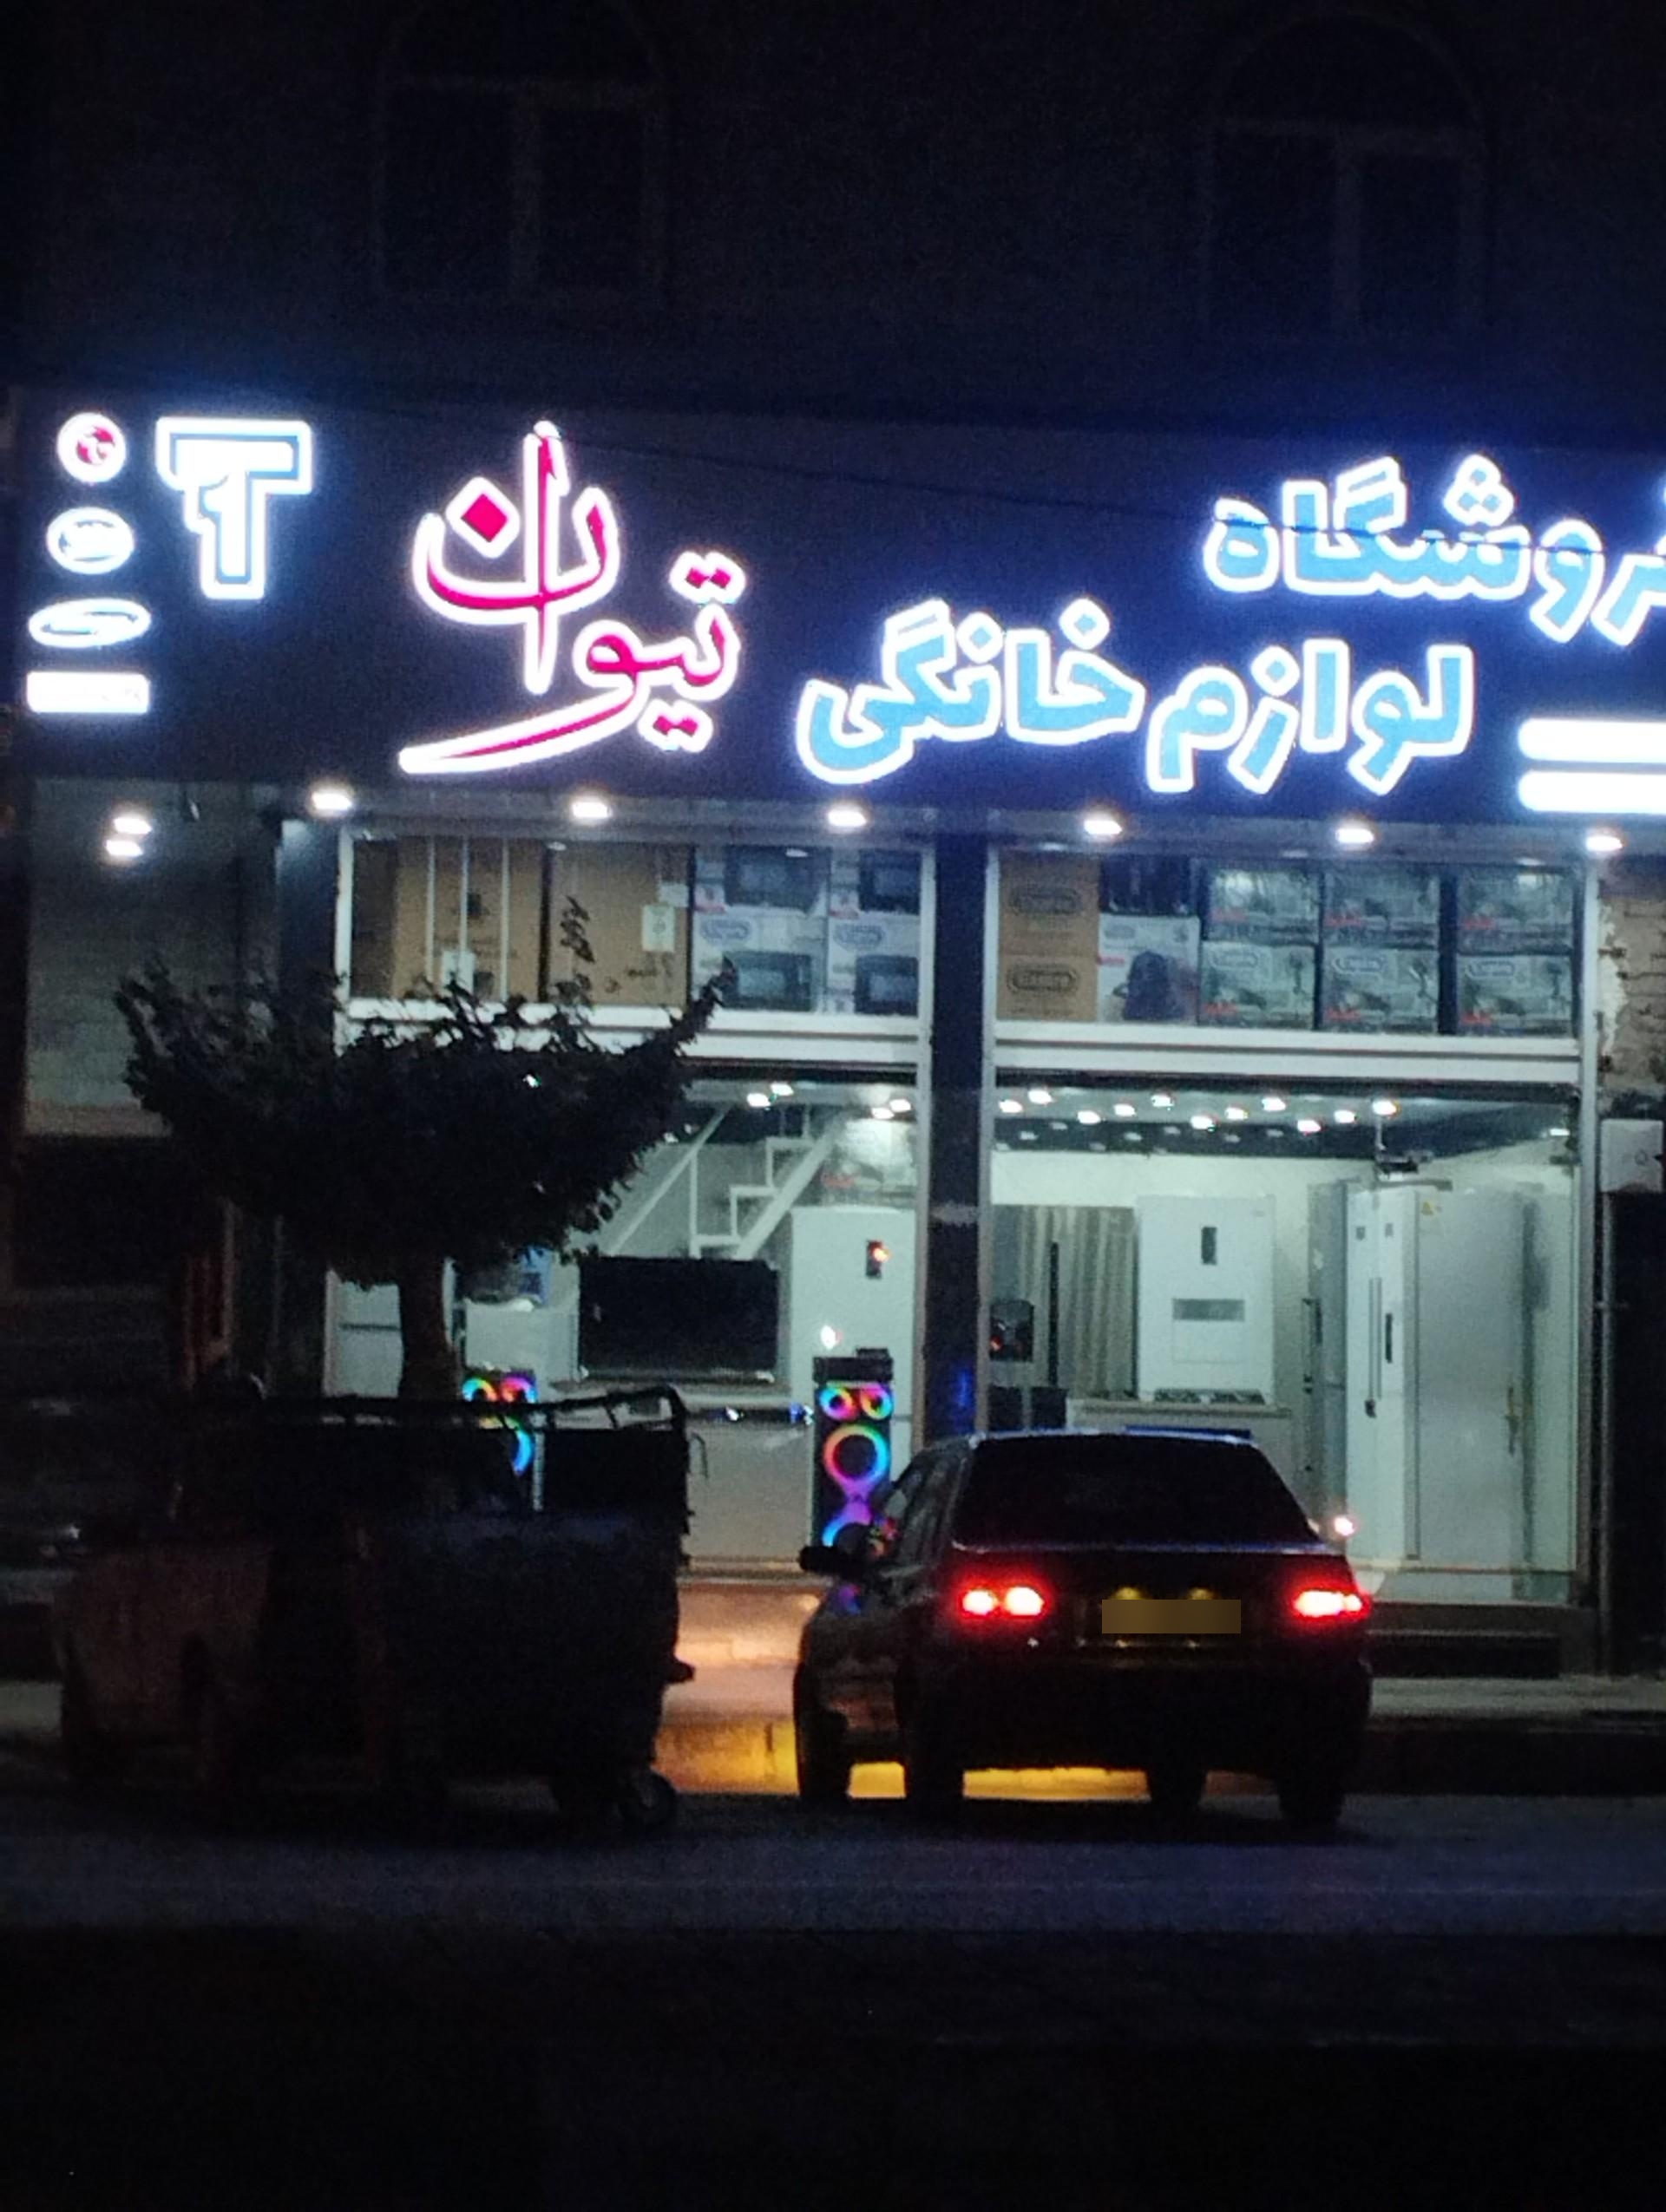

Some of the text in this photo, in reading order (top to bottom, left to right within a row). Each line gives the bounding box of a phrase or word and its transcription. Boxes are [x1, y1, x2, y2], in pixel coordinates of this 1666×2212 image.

[1204, 453, 1666, 646] روشگاه
[797, 599, 1473, 795] لوازم خانگی
